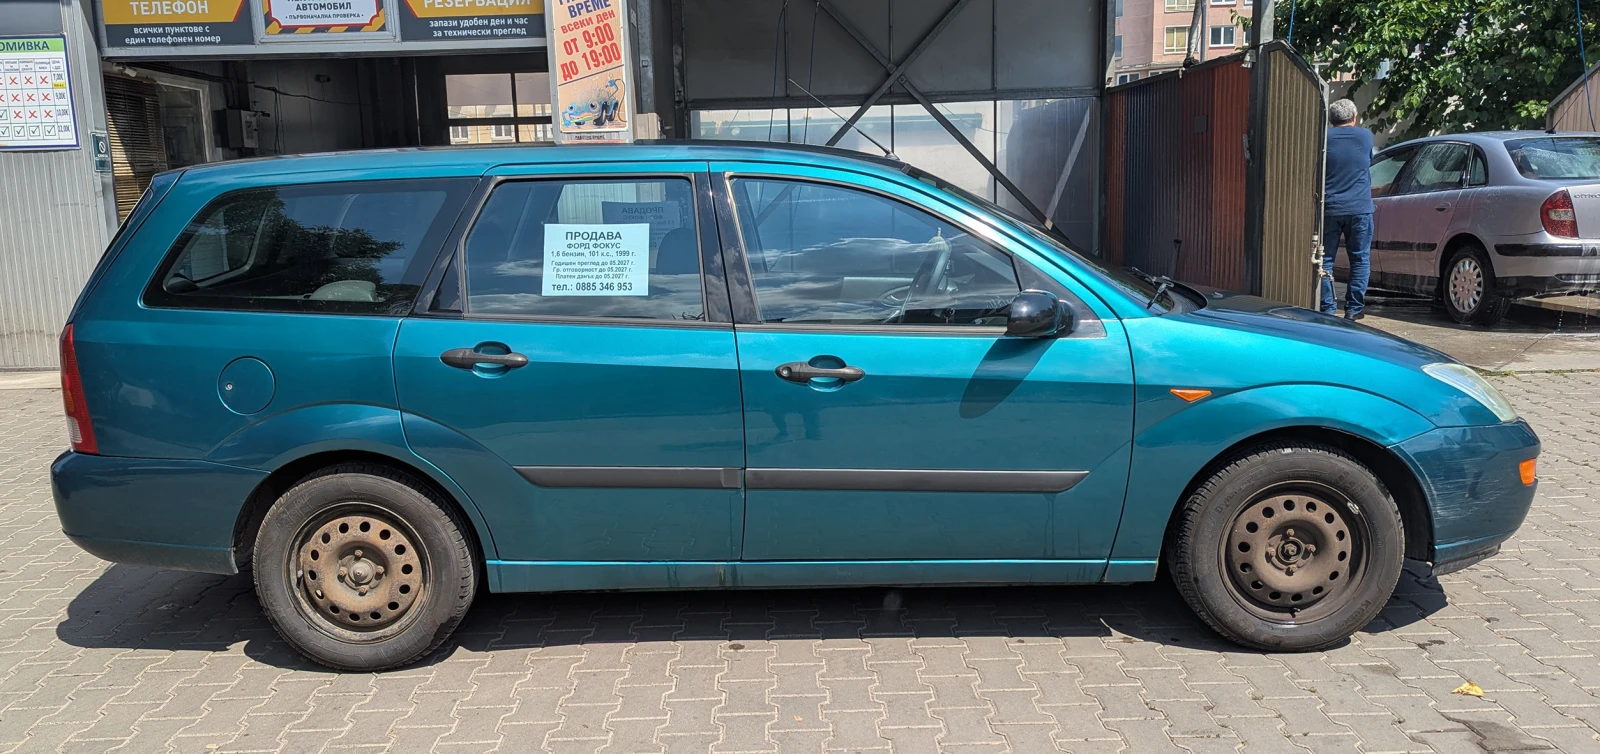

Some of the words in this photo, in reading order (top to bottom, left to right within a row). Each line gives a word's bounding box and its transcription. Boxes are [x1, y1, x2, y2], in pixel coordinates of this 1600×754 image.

[129, 0, 209, 15] ТЕЛЕФОН
[295, 2, 352, 11] АВТОМОБИЛ
[567, 0, 611, 18] ВРЕМЕ
[429, 19, 458, 28] запази
[459, 17, 488, 28] удобен
[490, 18, 505, 27] ден
[514, 17, 529, 25] час
[561, 16, 594, 34] всеки
[595, 9, 616, 24] ден
[133, 26, 164, 34] всички
[165, 25, 204, 35] пунктове
[204, 25, 210, 33] с
[432, 29, 442, 37] за
[443, 28, 491, 37] технически
[493, 26, 527, 36] преглед
[582, 22, 615, 49] 9:00
[124, 37, 146, 45] един
[146, 34, 194, 45] телефонен
[194, 35, 221, 44] номер
[581, 42, 622, 71] 19:00
[565, 231, 623, 242] ПРОДАВА
[566, 242, 590, 250] ФОРД
[551, 250, 561, 258] 1,6
[561, 250, 587, 258] бензин,
[575, 282, 597, 291] 0885
[599, 282, 615, 291] 346
[617, 282, 633, 291] 953
